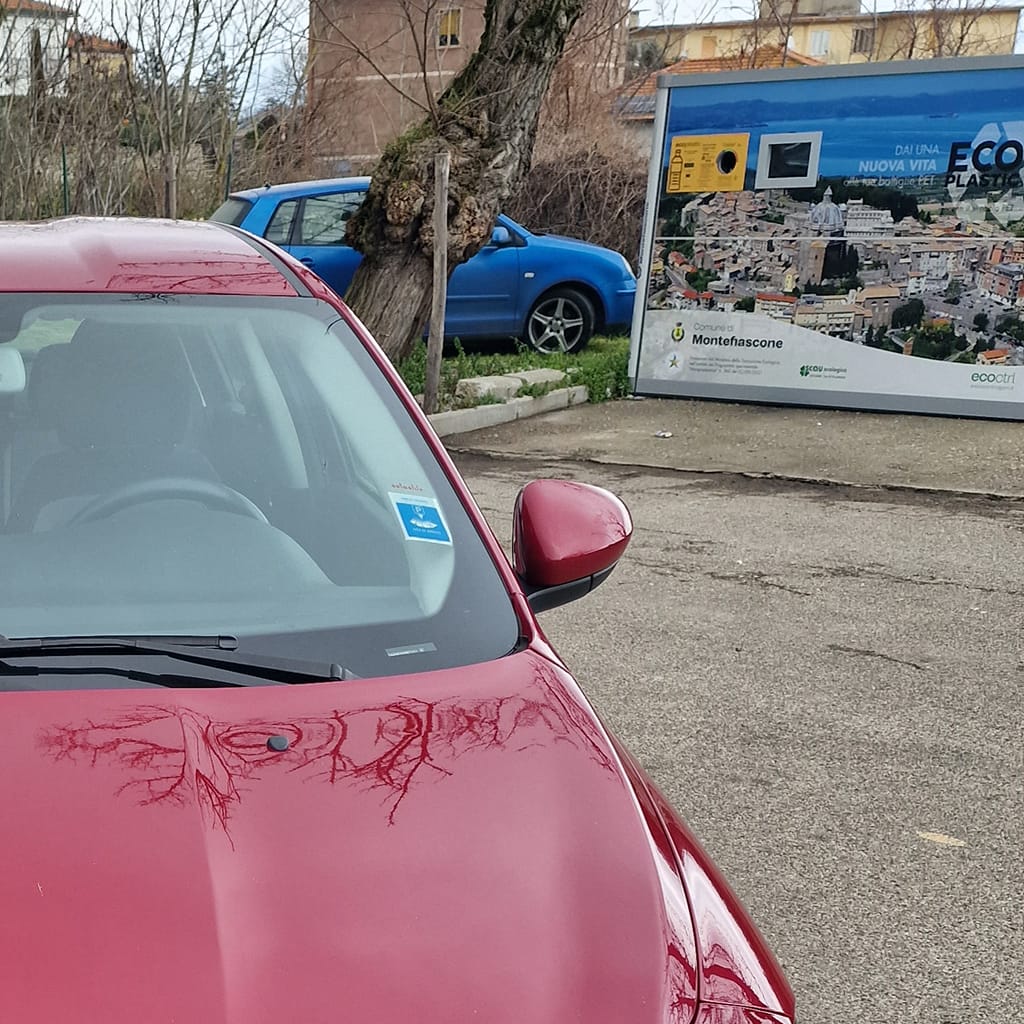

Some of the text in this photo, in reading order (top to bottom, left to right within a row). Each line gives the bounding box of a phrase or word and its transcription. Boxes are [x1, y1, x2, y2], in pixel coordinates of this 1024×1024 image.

[895, 144, 940, 156] DAI UNA
[947, 140, 1024, 172] ECO
[858, 159, 937, 173] NUOVA VITA
[691, 334, 784, 349] Montefiascone
